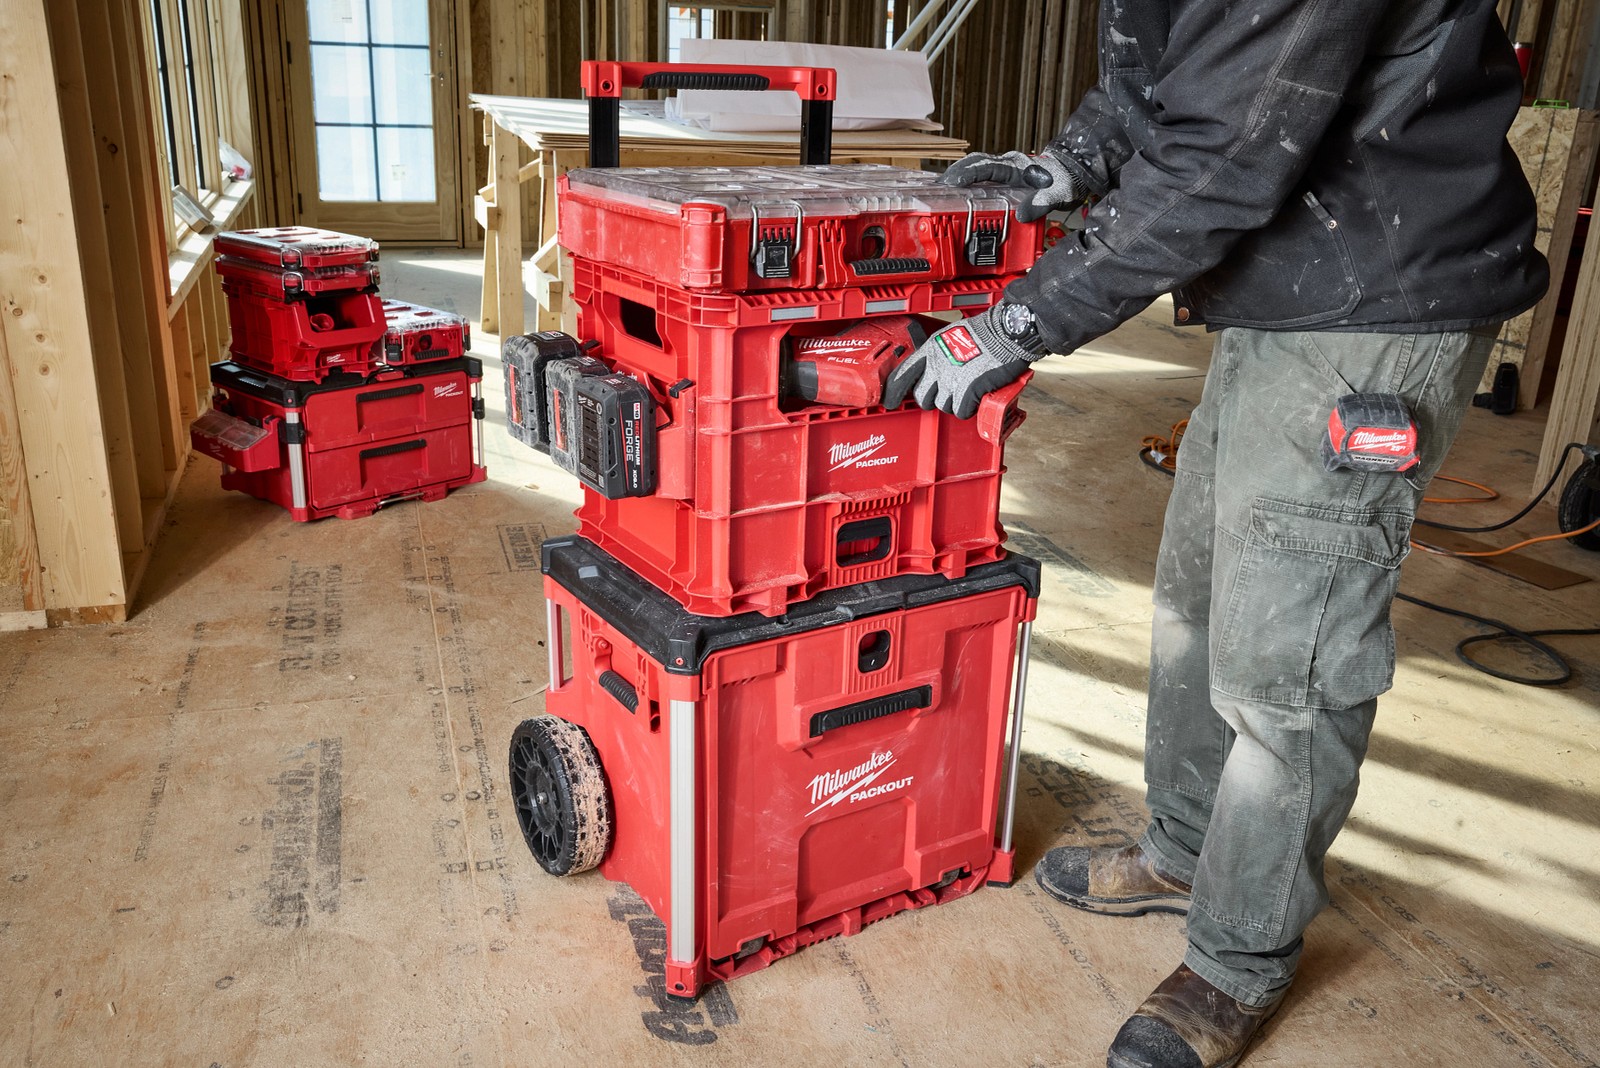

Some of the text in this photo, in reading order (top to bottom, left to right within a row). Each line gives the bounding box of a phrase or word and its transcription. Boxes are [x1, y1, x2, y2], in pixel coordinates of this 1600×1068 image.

[798, 338, 872, 349] Milwaukee
[827, 356, 860, 365] FUEL
[625, 420, 634, 461] FORGE
[1353, 431, 1407, 445] Milwaukee
[827, 433, 886, 465] Milwaukee
[855, 455, 899, 469] PACKOUT
[805, 750, 894, 805] Milwaukee
[849, 776, 914, 804] PACKOUT
